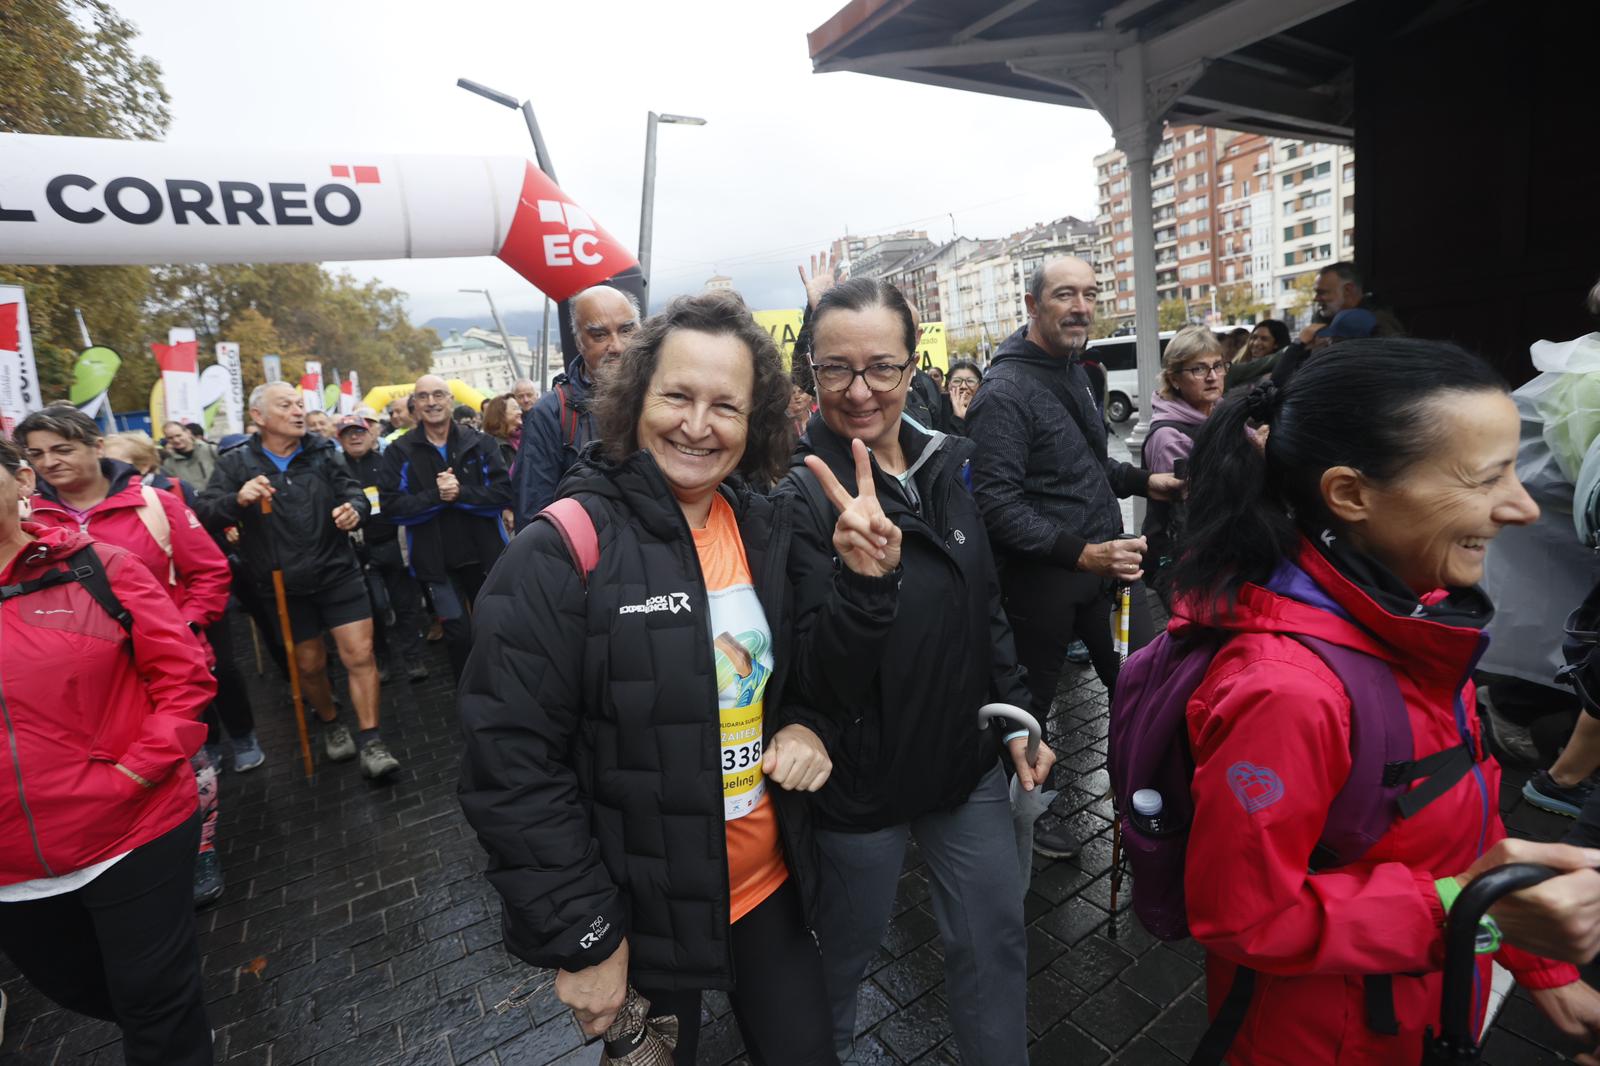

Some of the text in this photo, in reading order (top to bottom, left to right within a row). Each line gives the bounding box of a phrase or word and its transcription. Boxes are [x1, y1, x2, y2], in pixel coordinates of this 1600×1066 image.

[46, 173, 362, 226] CORREO
[543, 233, 604, 266] EC
[720, 720, 745, 729] LIDARIA
[723, 741, 761, 770] 338
[723, 774, 754, 790] ueling
[589, 915, 604, 931] 750
